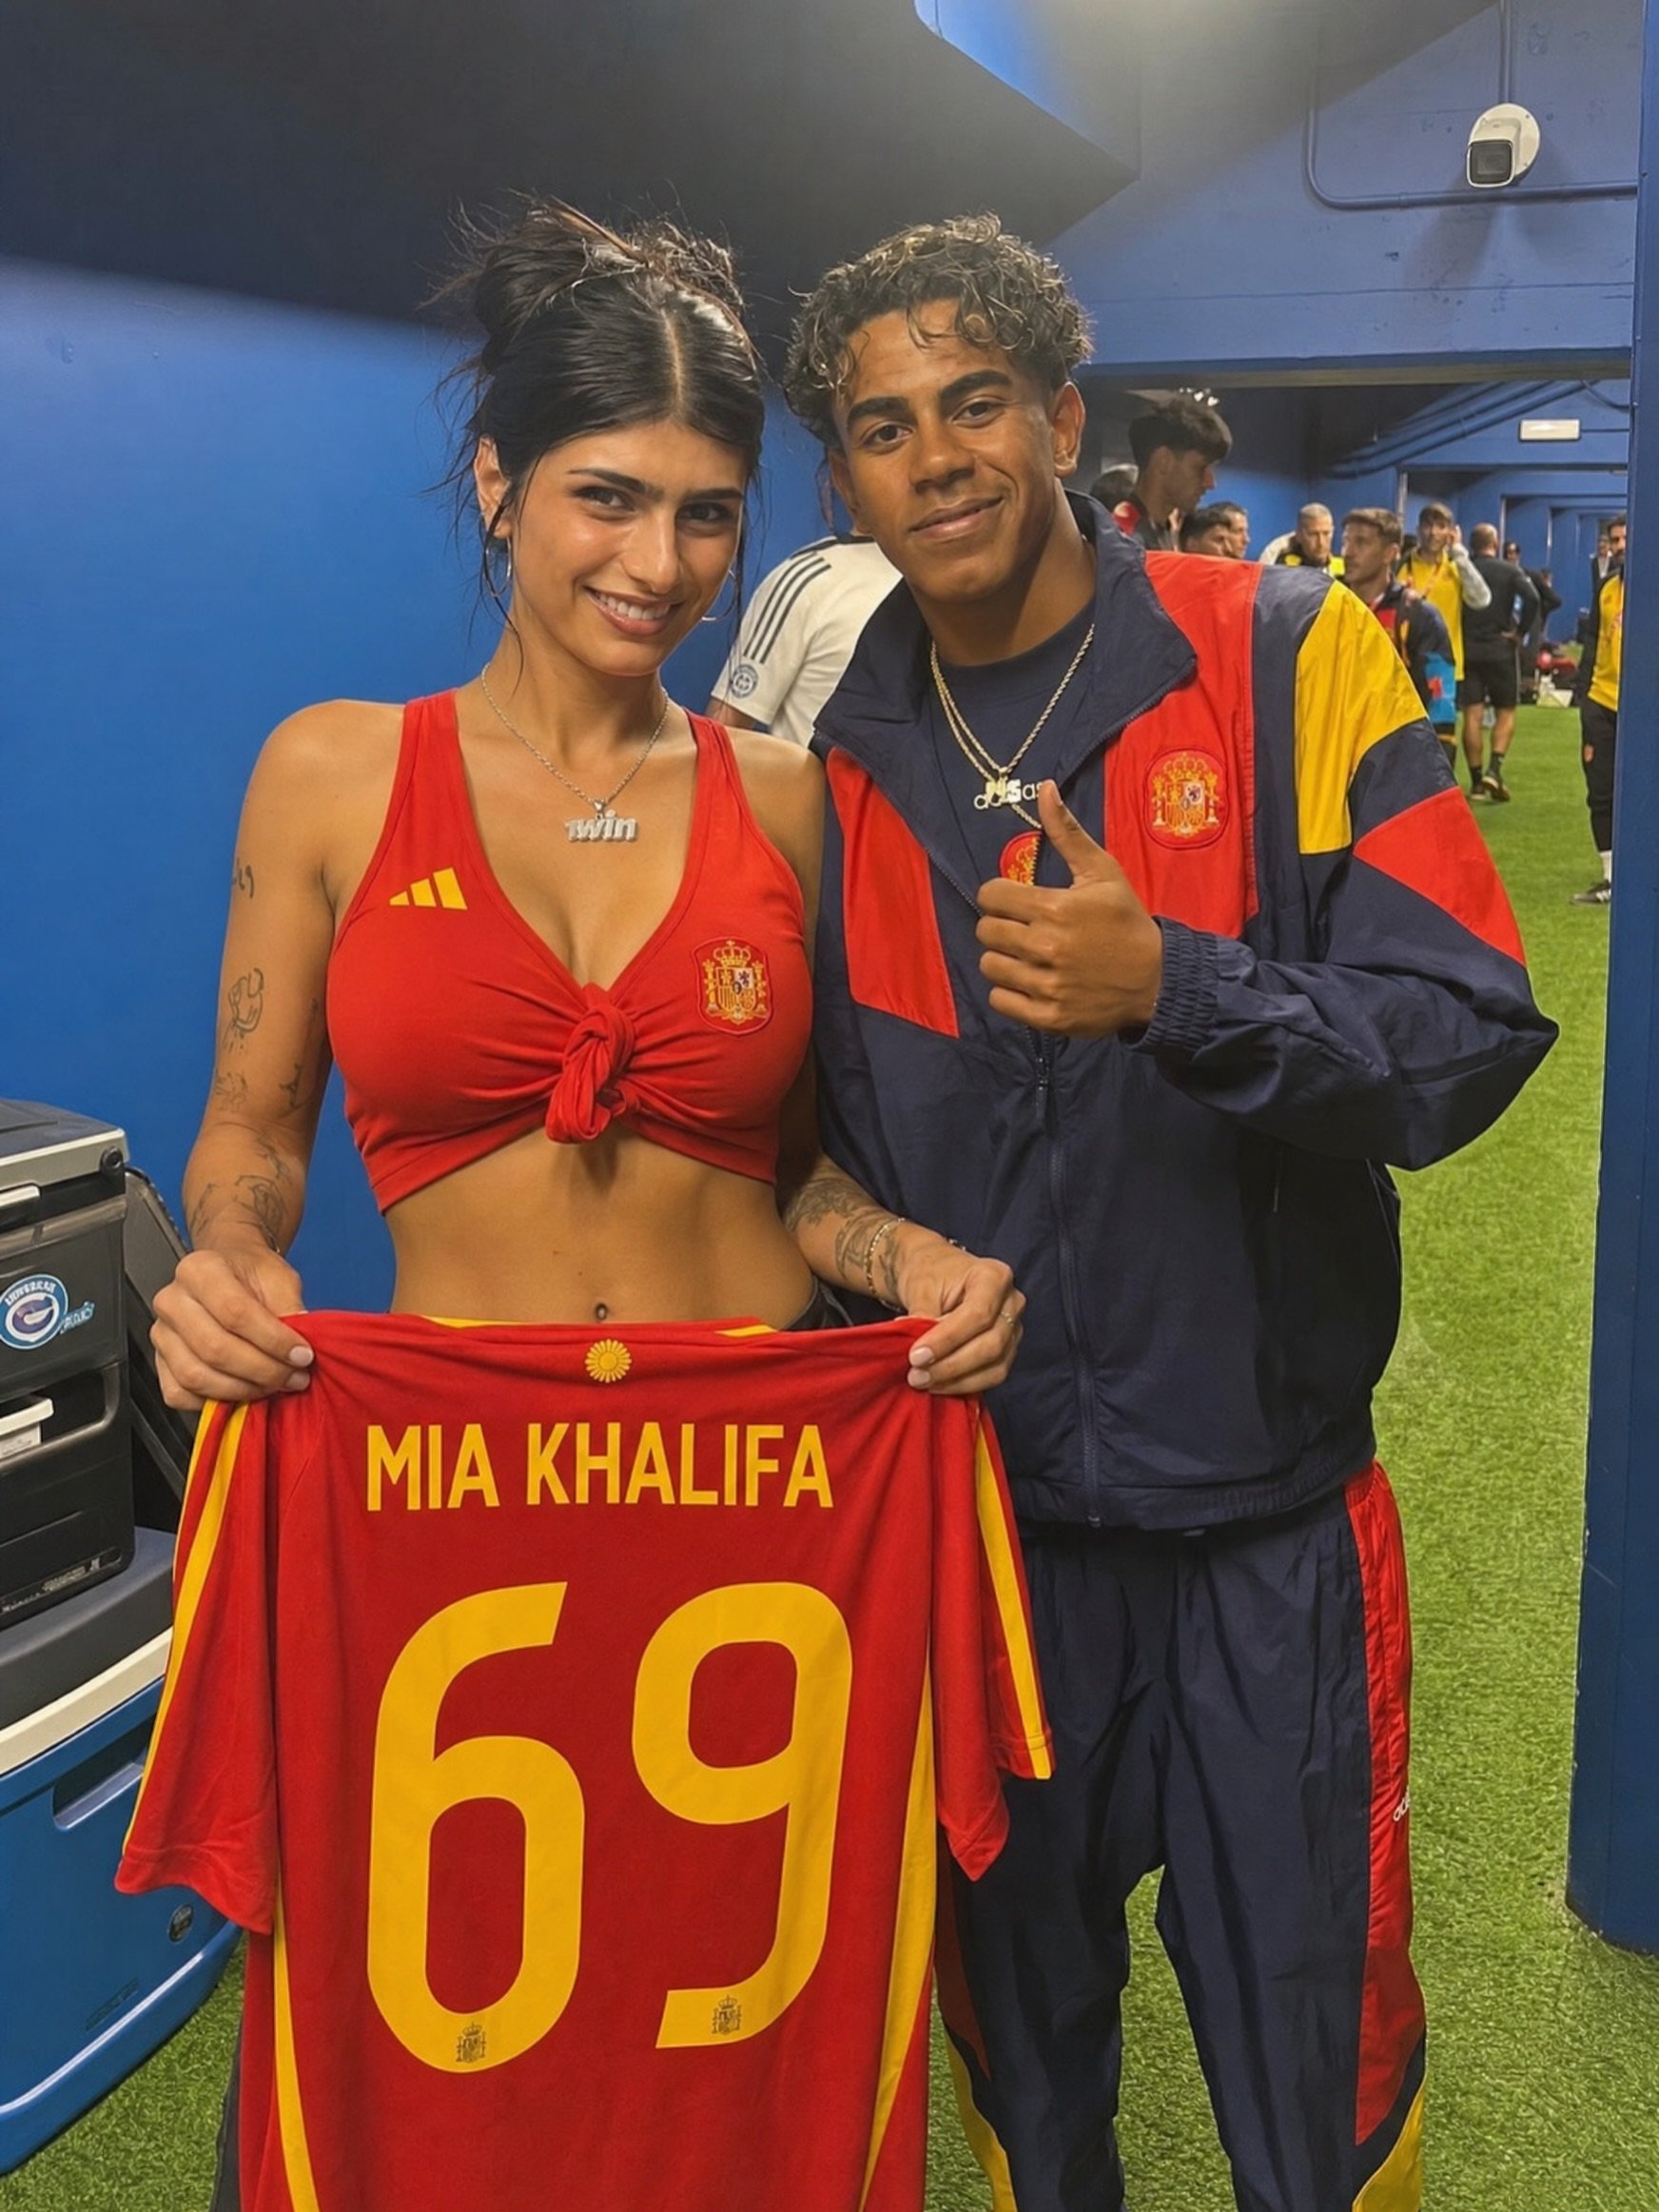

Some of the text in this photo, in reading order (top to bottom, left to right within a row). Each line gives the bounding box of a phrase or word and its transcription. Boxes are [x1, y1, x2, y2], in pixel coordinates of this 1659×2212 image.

[367, 1421, 833, 1511] MIA KHALIFA
[367, 1581, 853, 2073] 69
